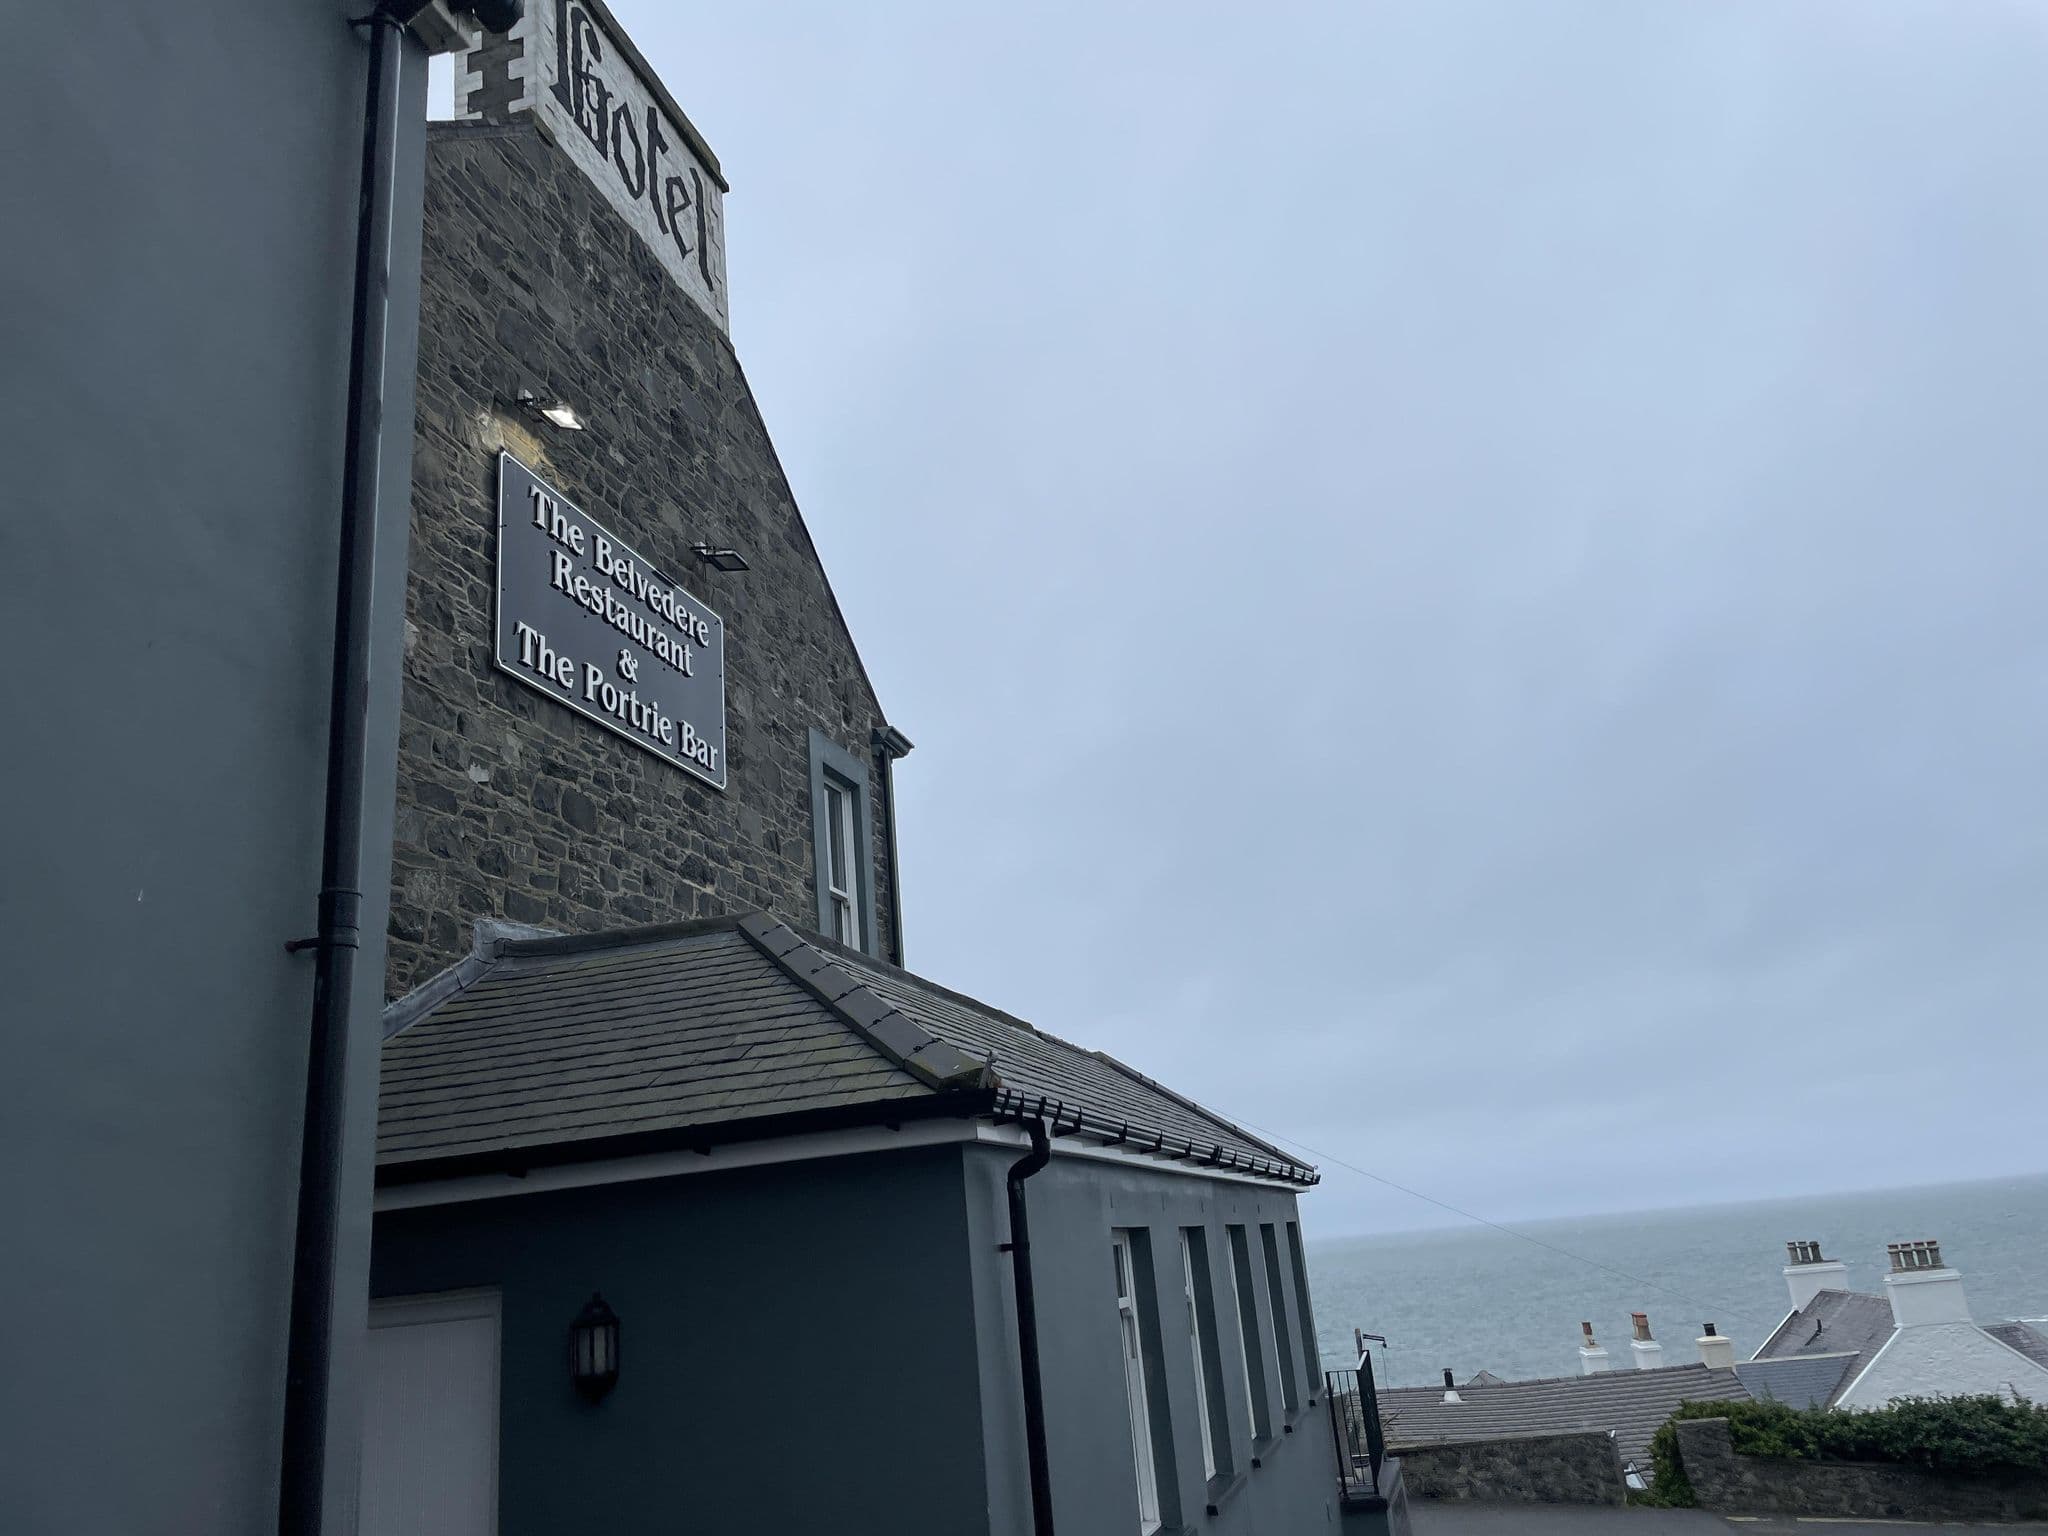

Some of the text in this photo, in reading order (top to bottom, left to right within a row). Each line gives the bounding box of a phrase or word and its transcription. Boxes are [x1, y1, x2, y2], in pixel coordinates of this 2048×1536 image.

[530, 484, 710, 647] The Belvedere
[550, 550, 694, 677] Restaurant
[515, 621, 718, 770] The Portrie Bar
[618, 648, 638, 683] &
